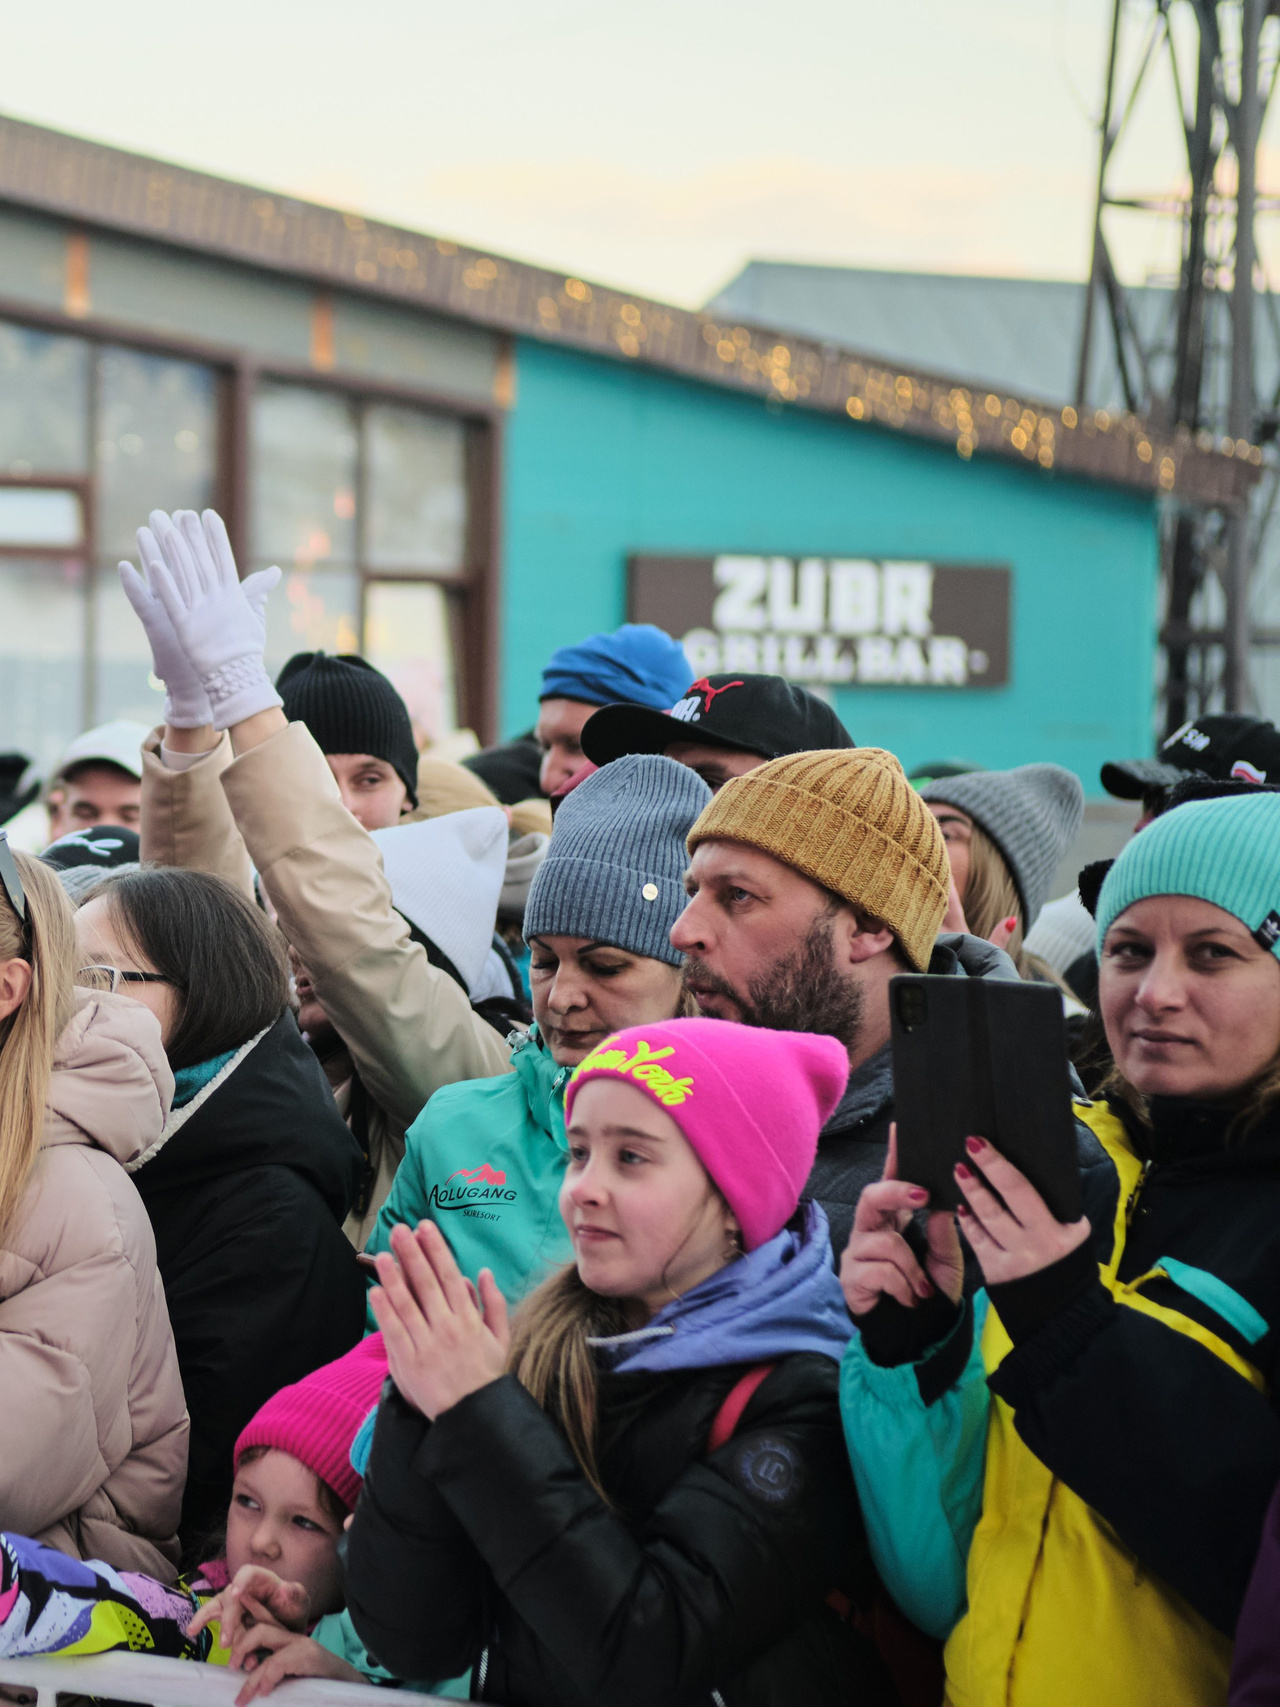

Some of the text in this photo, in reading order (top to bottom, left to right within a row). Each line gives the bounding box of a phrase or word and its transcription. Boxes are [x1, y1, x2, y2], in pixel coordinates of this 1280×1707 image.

[713, 555, 933, 635] ZUBR
[681, 627, 968, 686] GRILL BAR
[428, 1184, 518, 1209] AOLUGANG
